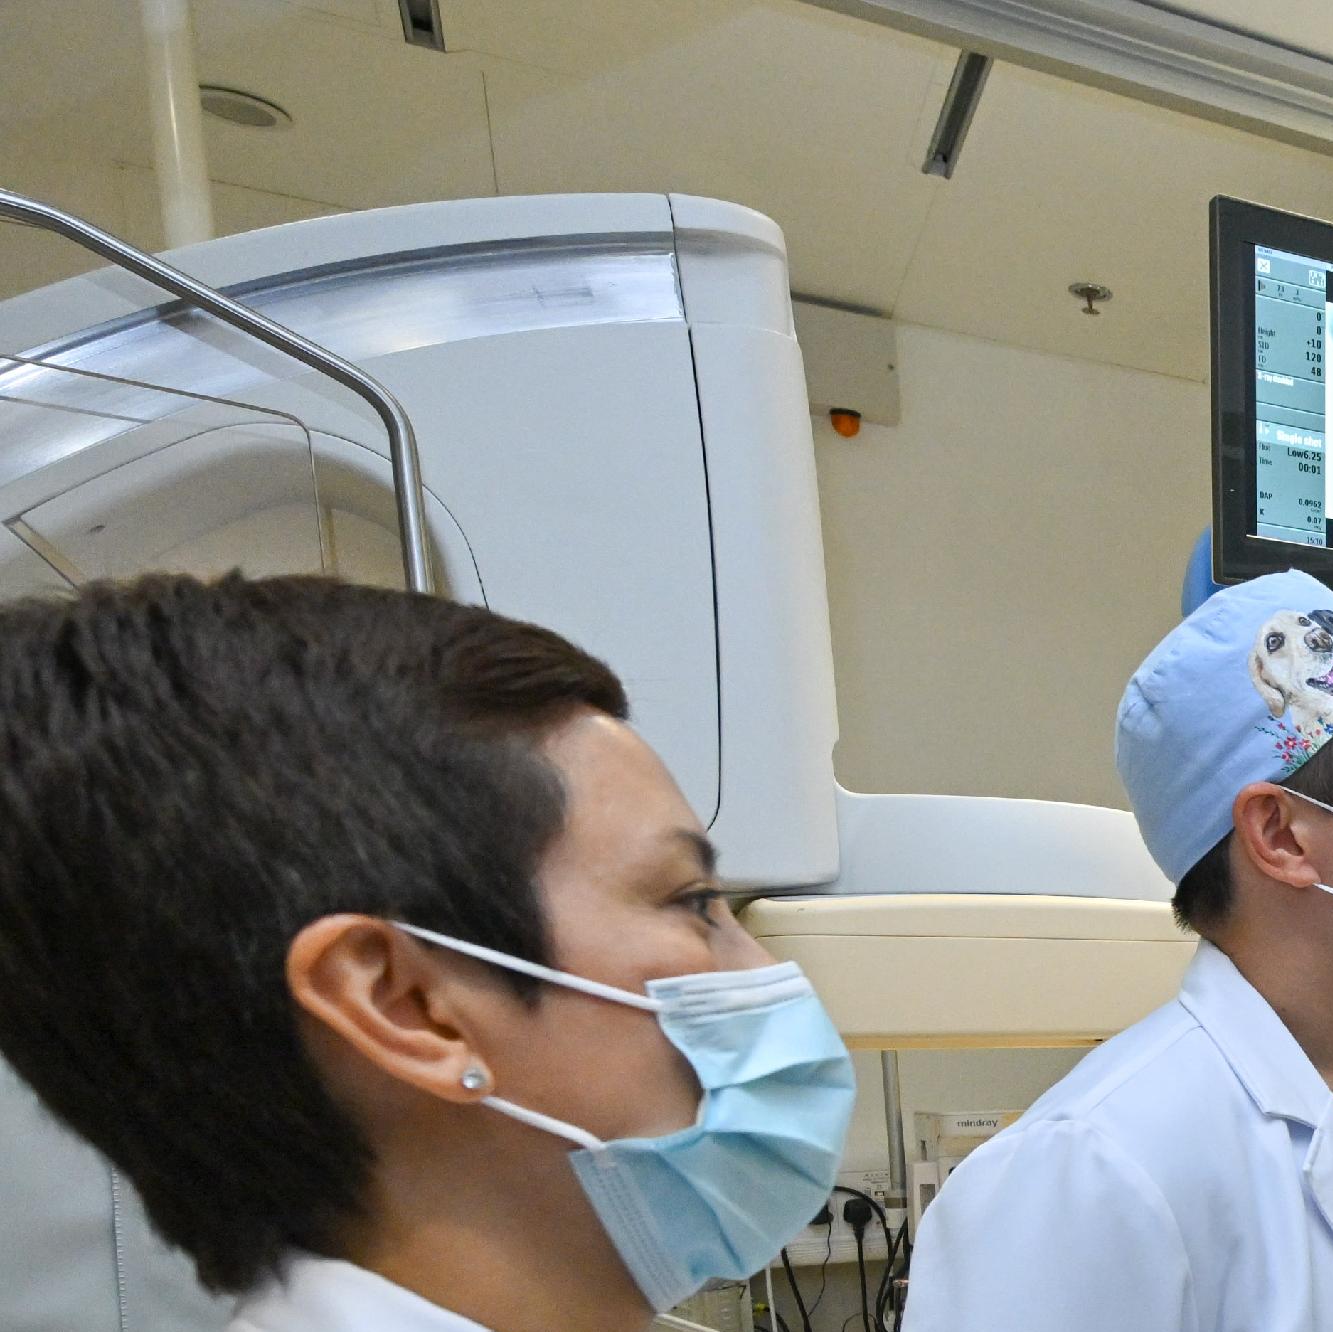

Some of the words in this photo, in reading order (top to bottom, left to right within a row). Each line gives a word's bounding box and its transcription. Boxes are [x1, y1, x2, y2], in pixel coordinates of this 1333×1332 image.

[1305, 351, 1322, 363] 120
[1310, 366, 1322, 377] 48
[1286, 446, 1322, 462] Low6.25
[1298, 461, 1321, 475] 00:01
[957, 1119, 998, 1128] mindray
